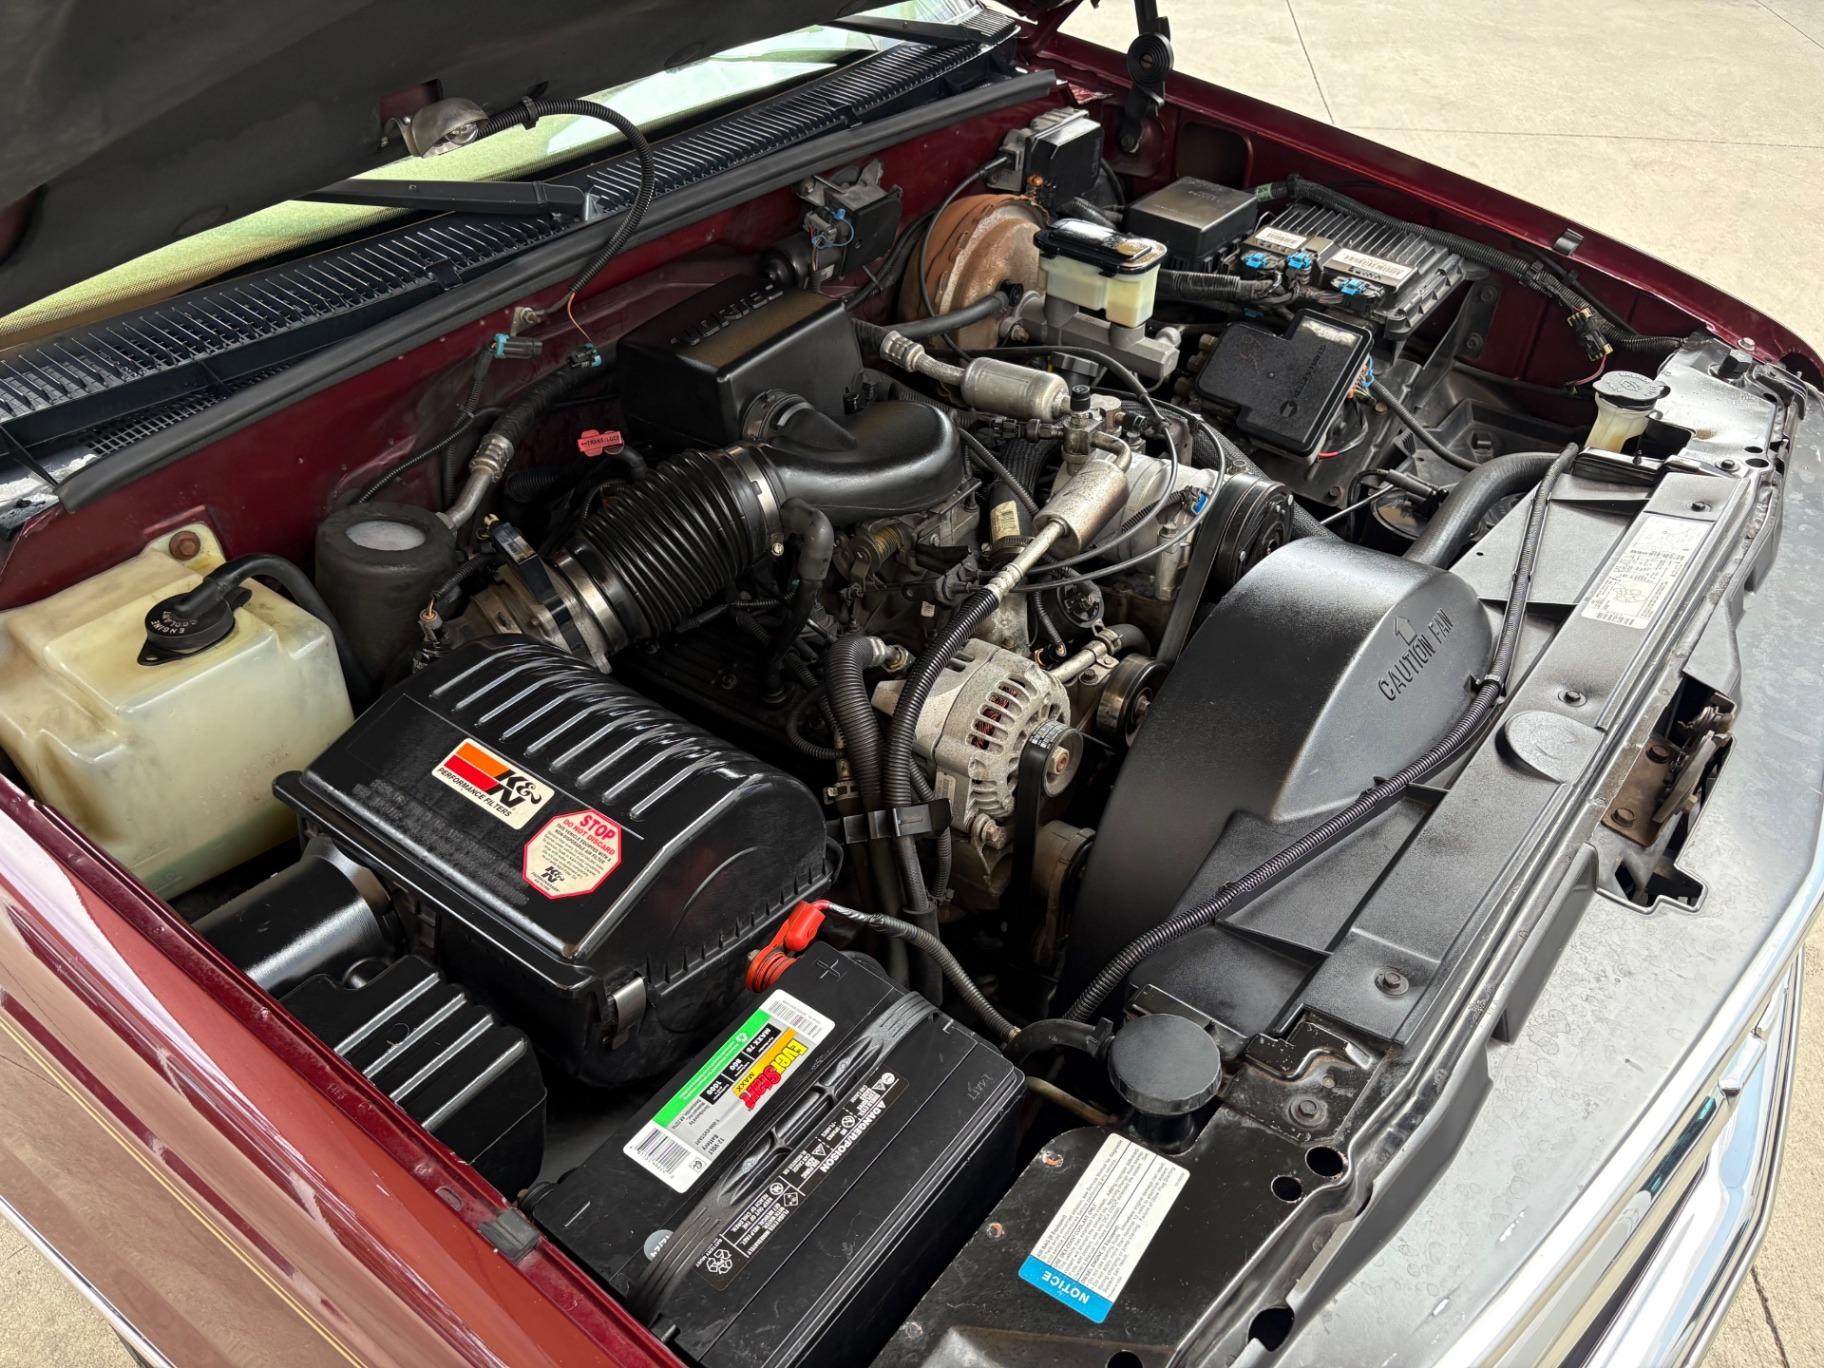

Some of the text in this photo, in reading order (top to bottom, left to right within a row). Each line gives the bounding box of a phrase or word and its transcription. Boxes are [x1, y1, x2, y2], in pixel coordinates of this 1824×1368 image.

[1378, 608, 1454, 701] CAUTION FAN
[437, 767, 512, 817] PERFORMANCE FILTERS
[562, 817, 616, 856] DO NOT DISCARD
[580, 814, 616, 840] STOP
[752, 1026, 771, 1046] MAXX
[728, 1056, 742, 1071] 800
[737, 1034, 809, 1112] EverStart
[705, 1078, 722, 1096] 1000
[735, 1070, 755, 1093] MAXX
[700, 1132, 719, 1151] Battery
[821, 1108, 881, 1173] DANGER/POISON
[1041, 1270, 1090, 1304] NOTICE
